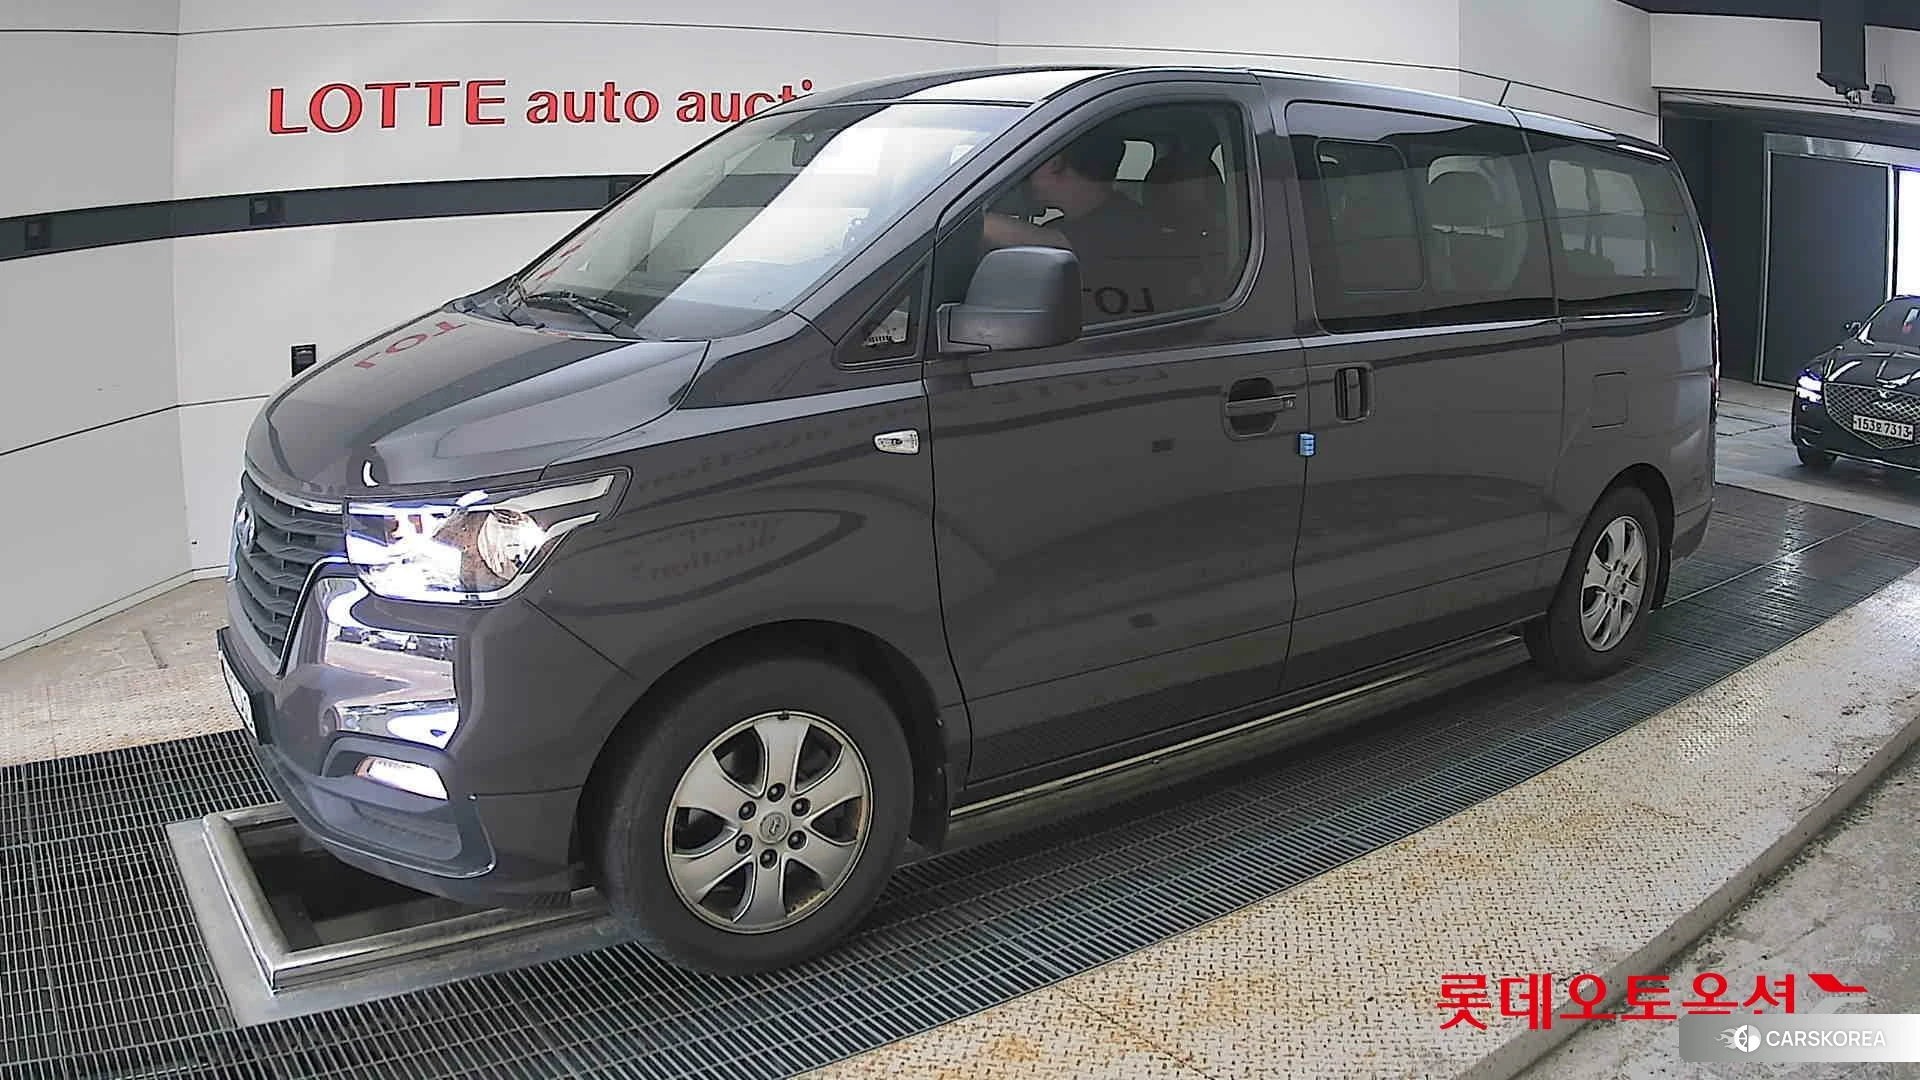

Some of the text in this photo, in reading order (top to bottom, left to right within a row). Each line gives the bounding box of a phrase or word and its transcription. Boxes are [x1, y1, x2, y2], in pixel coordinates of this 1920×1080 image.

[268, 79, 506, 135] LOTTE
[526, 81, 660, 123] auto
[1883, 422, 1910, 438] 7313
